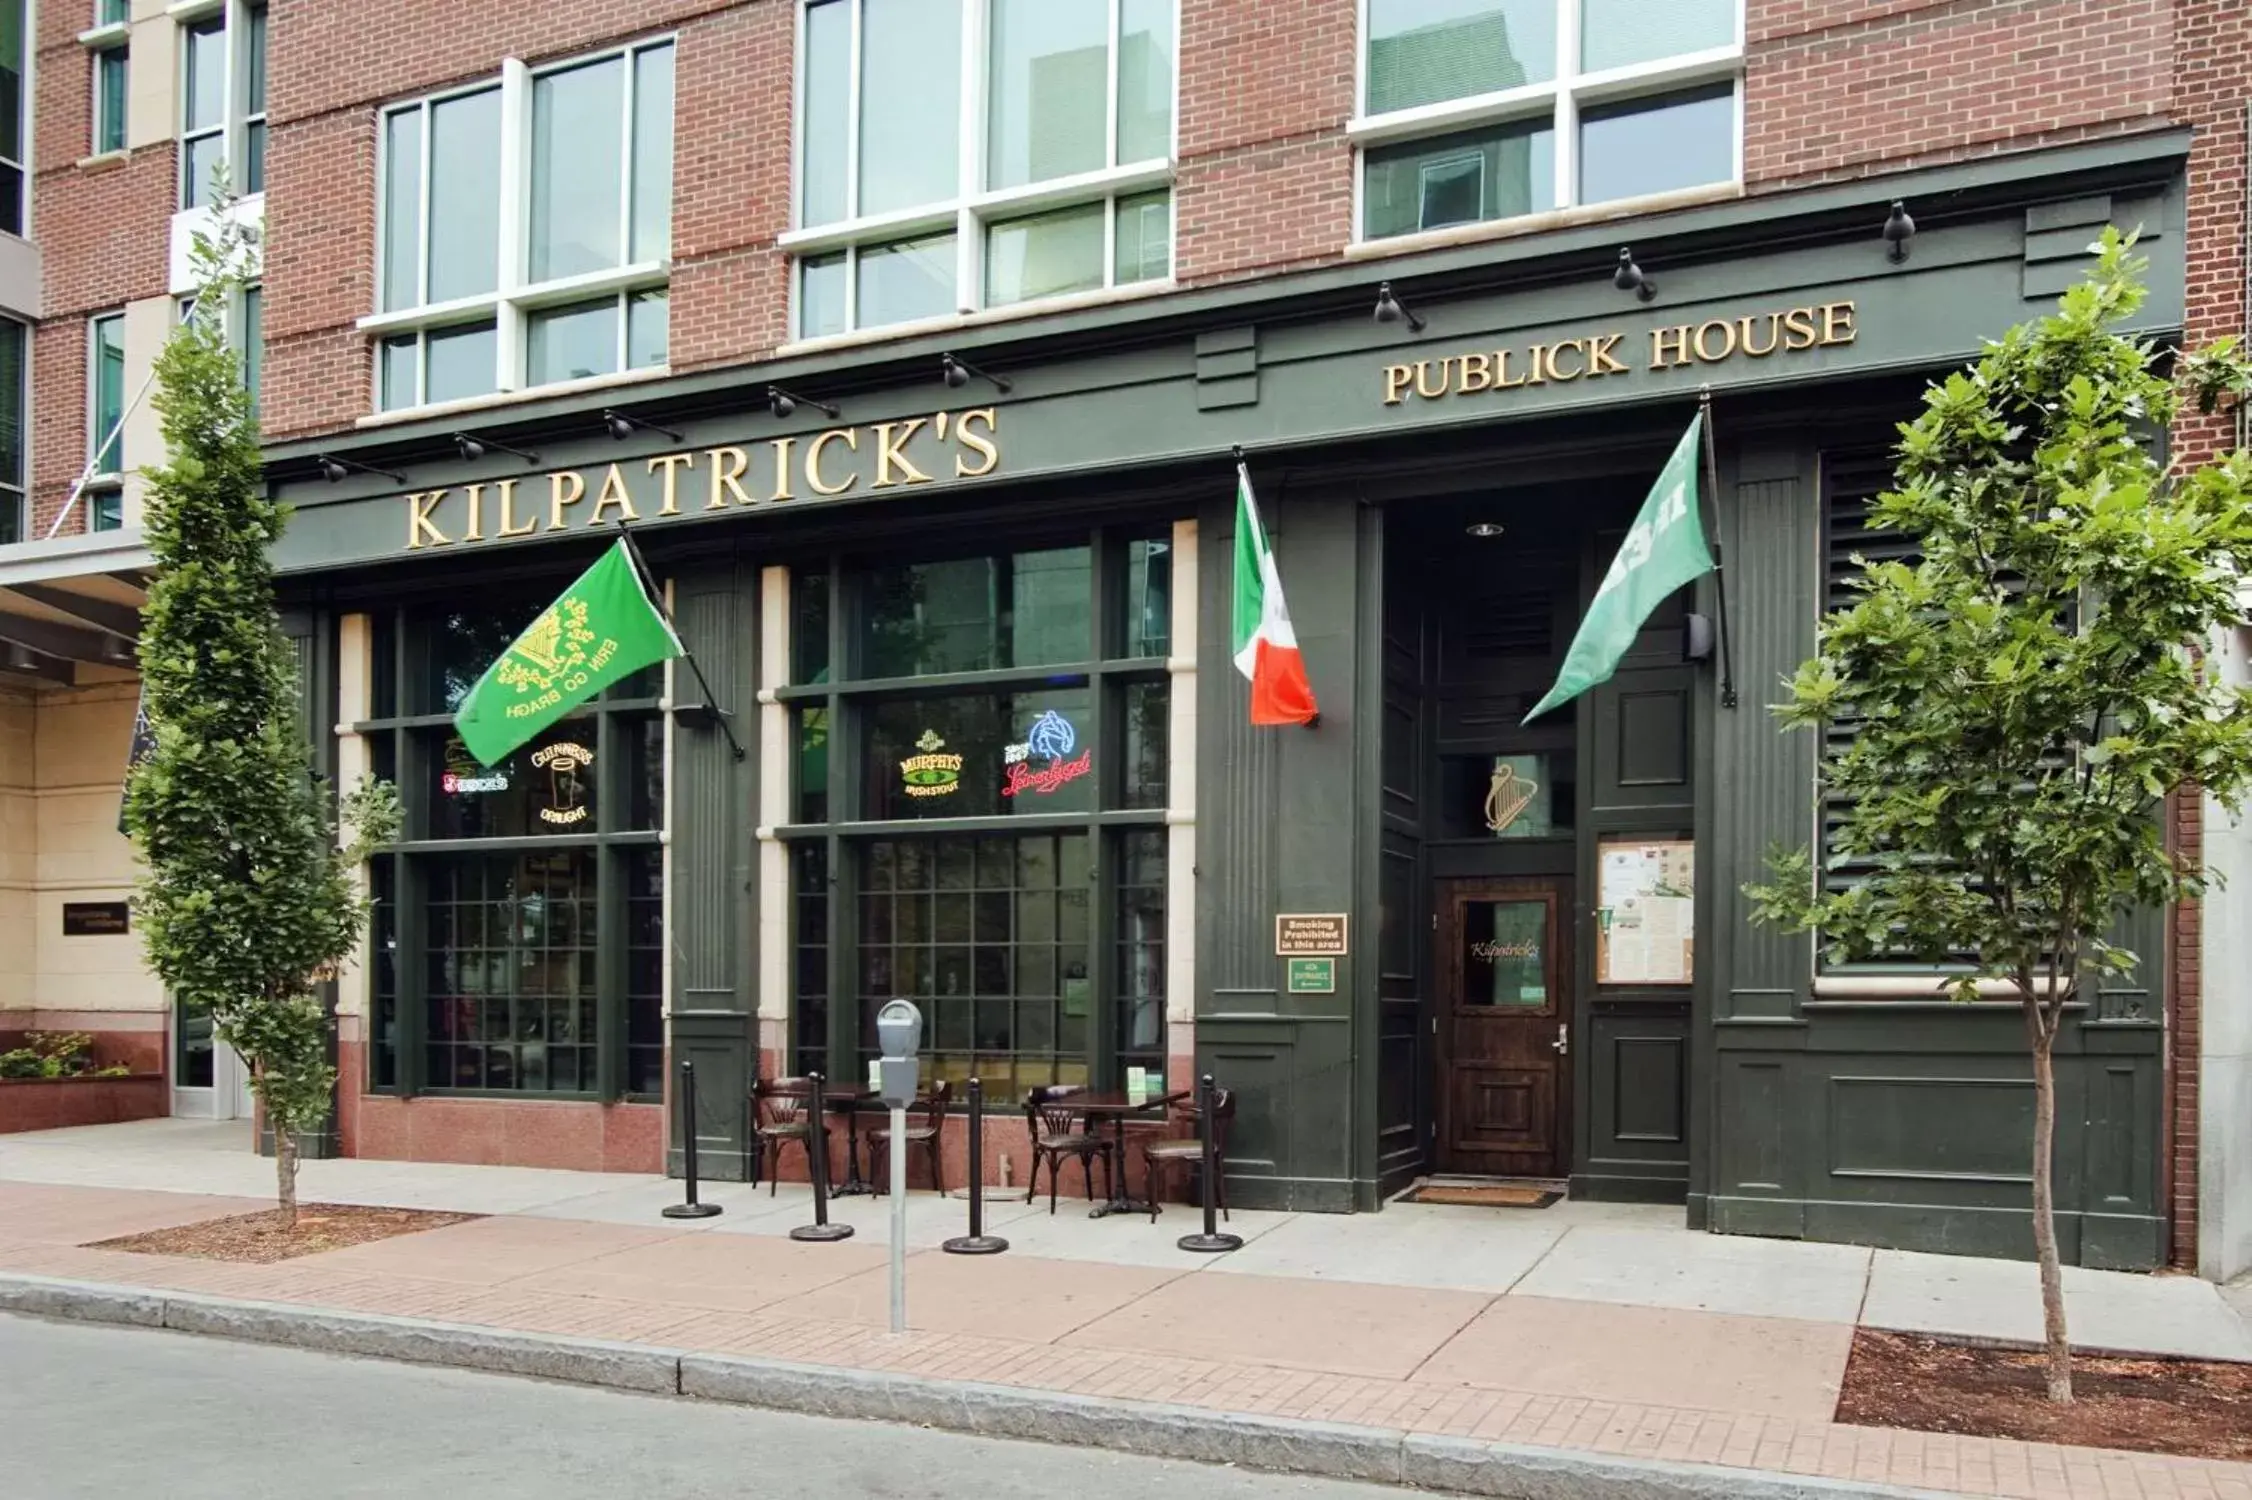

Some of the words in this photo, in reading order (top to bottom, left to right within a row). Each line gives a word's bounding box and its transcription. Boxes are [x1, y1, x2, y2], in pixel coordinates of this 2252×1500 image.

[1382, 333, 1631, 405] PUBLICK
[1648, 300, 1859, 370] HOUSE
[403, 406, 1000, 550] KILPATRICK'S
[531, 742, 594, 769] GUINNESS
[540, 806, 587, 824] DRAUGHT
